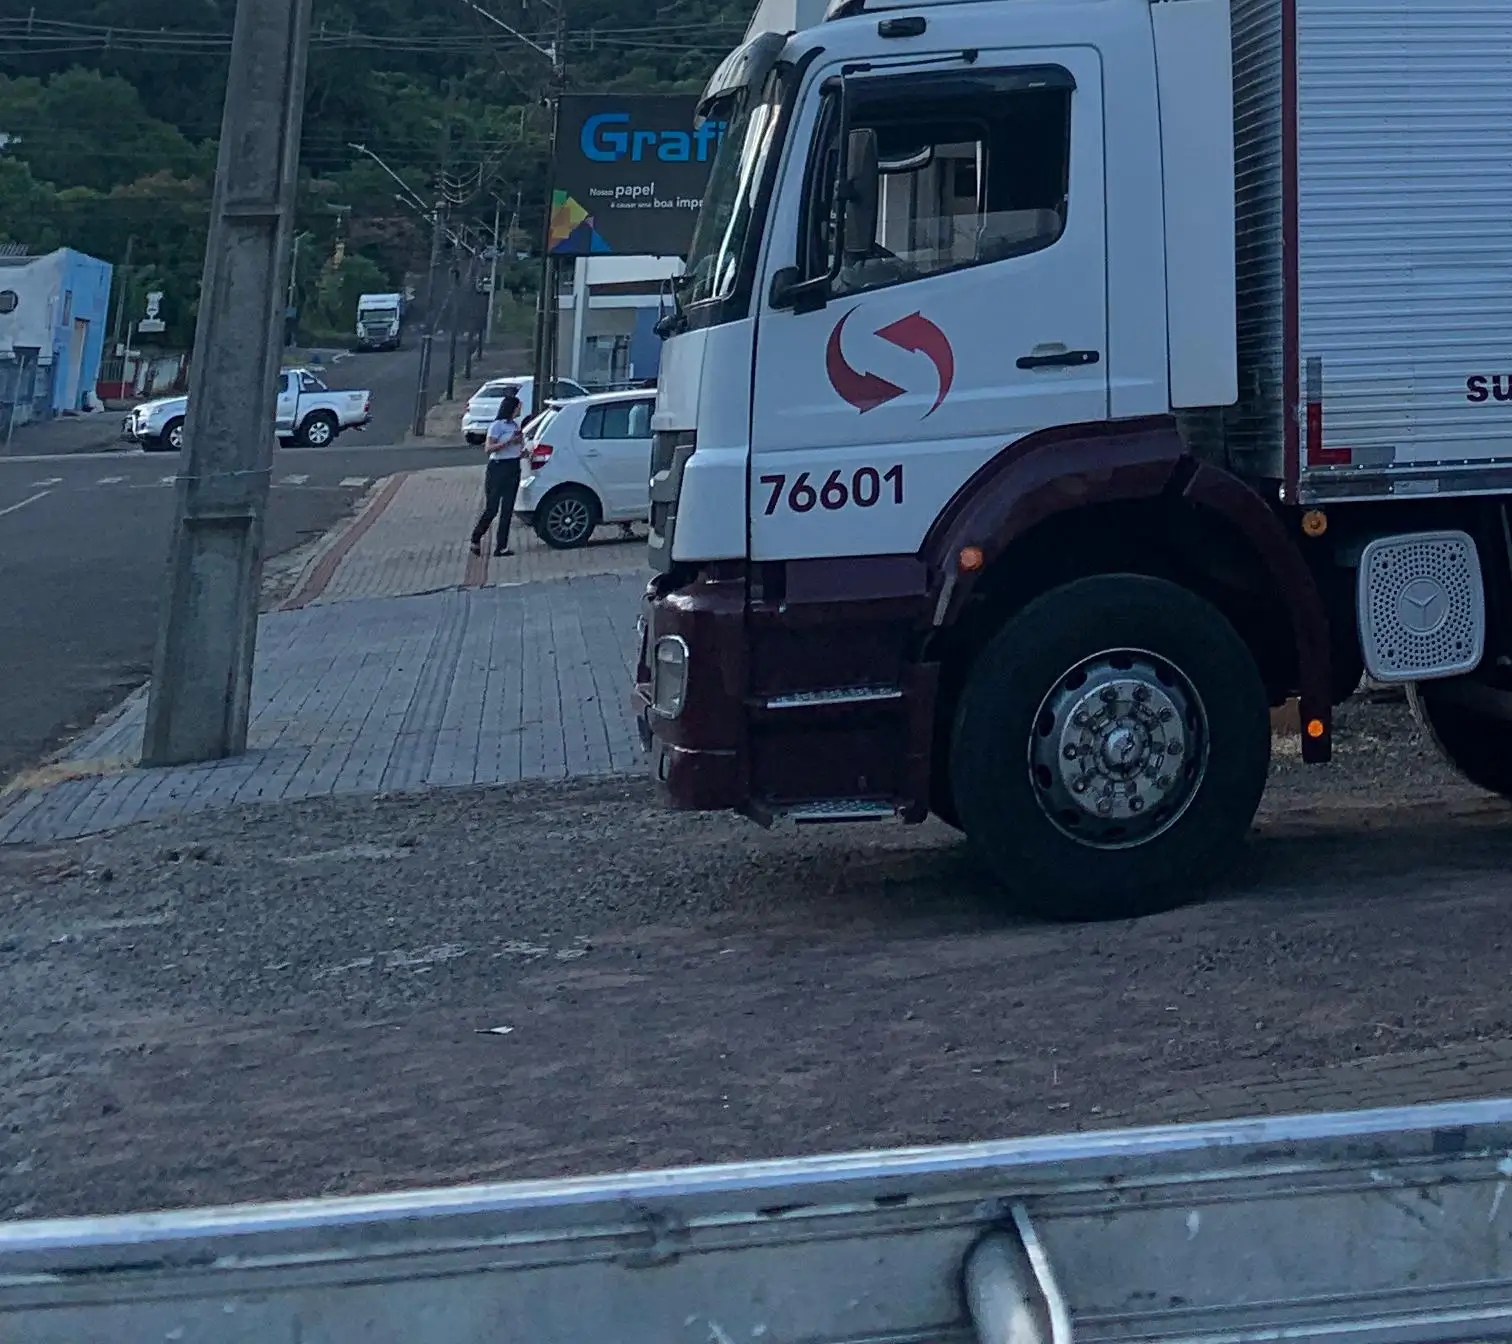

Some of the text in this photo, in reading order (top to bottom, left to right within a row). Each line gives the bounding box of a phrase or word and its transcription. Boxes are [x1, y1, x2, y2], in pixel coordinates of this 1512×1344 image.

[614, 182, 655, 199] papel
[653, 198, 673, 208] boa
[760, 464, 904, 516] 76601
